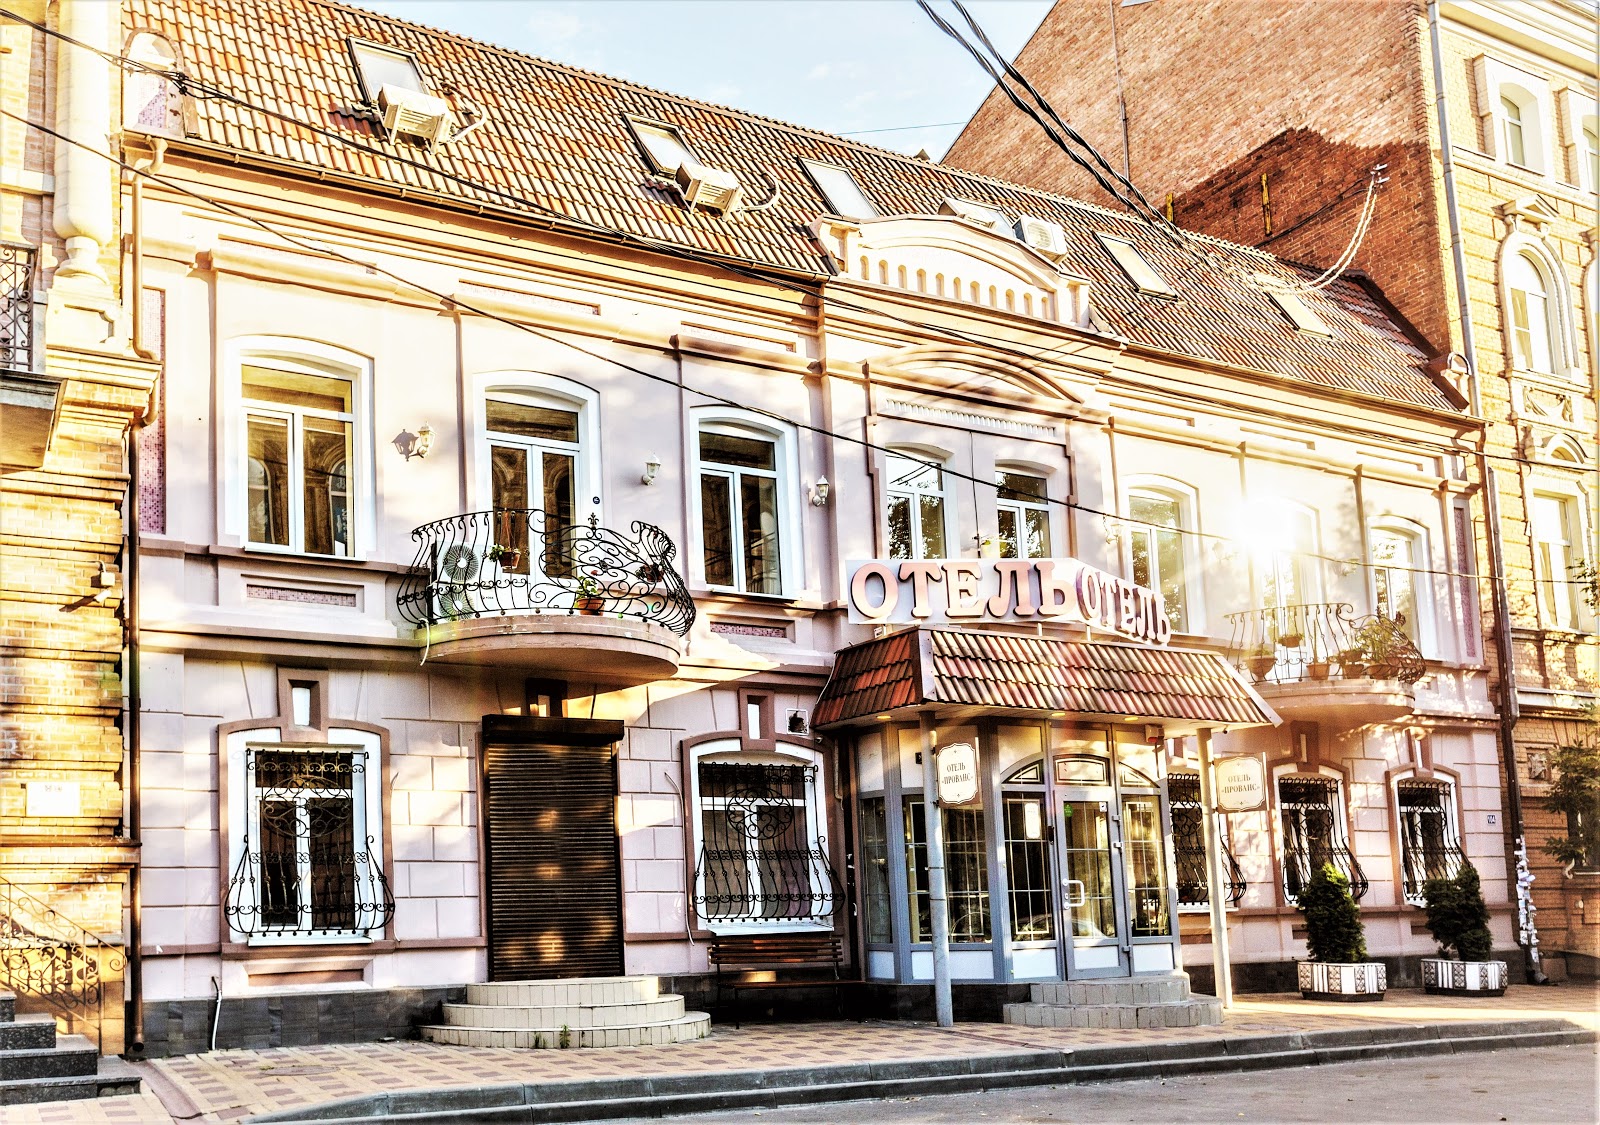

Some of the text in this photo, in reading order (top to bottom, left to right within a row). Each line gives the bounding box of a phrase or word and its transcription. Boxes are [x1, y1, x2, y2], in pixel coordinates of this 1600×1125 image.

[850, 561, 1078, 619] ОТЕЛЬ
[1076, 567, 1171, 645] ОТЕЛЬ
[946, 762, 966, 773] ОТЕЛЬ
[1228, 774, 1251, 783] ОТЕЛЬ
